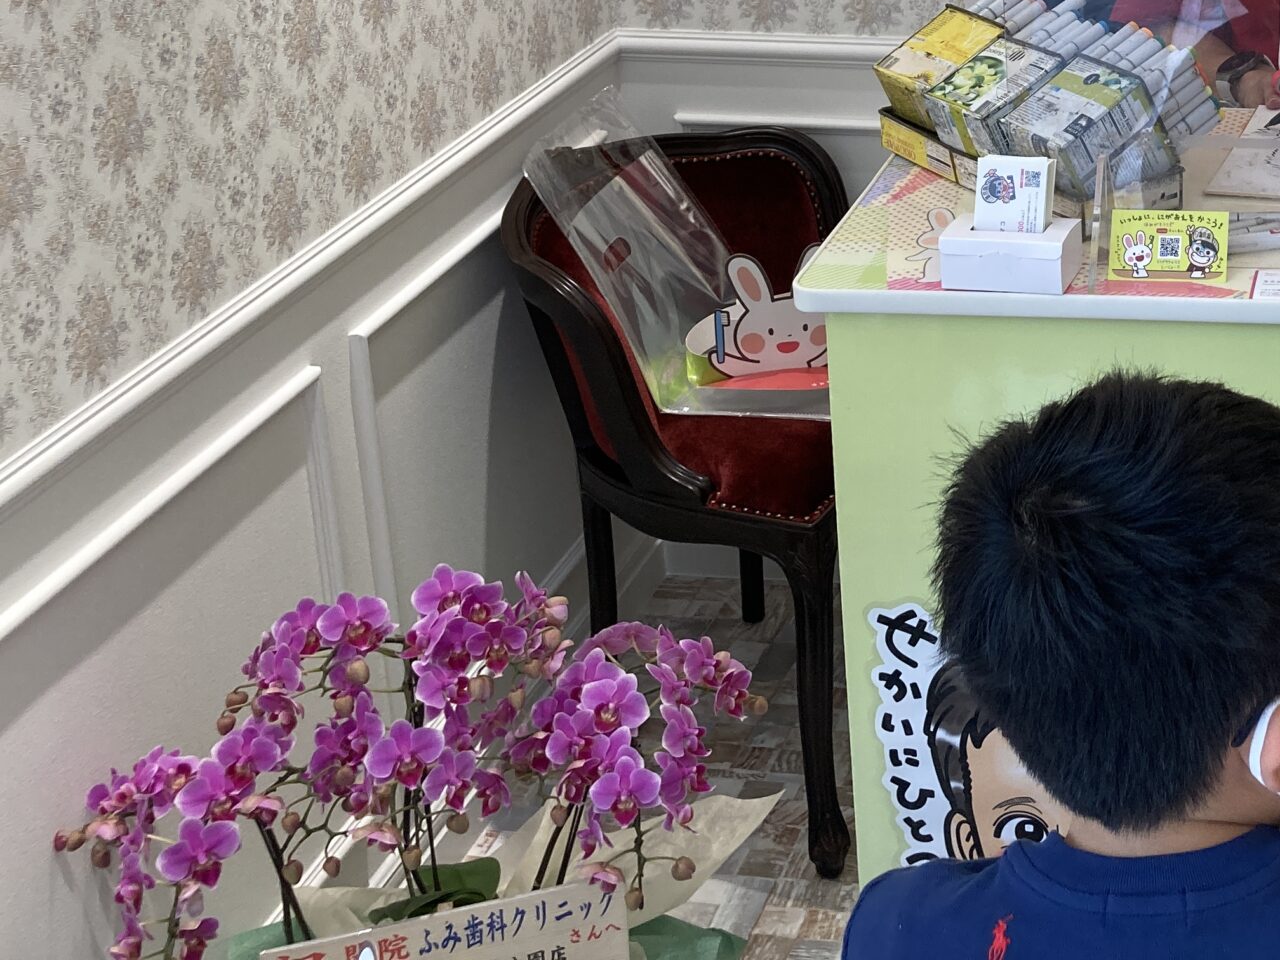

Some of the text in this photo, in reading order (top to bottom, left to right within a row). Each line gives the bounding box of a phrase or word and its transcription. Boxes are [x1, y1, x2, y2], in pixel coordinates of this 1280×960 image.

[419, 891, 613, 956] ふみ歯科クリニック
[569, 923, 622, 944] さんへ
